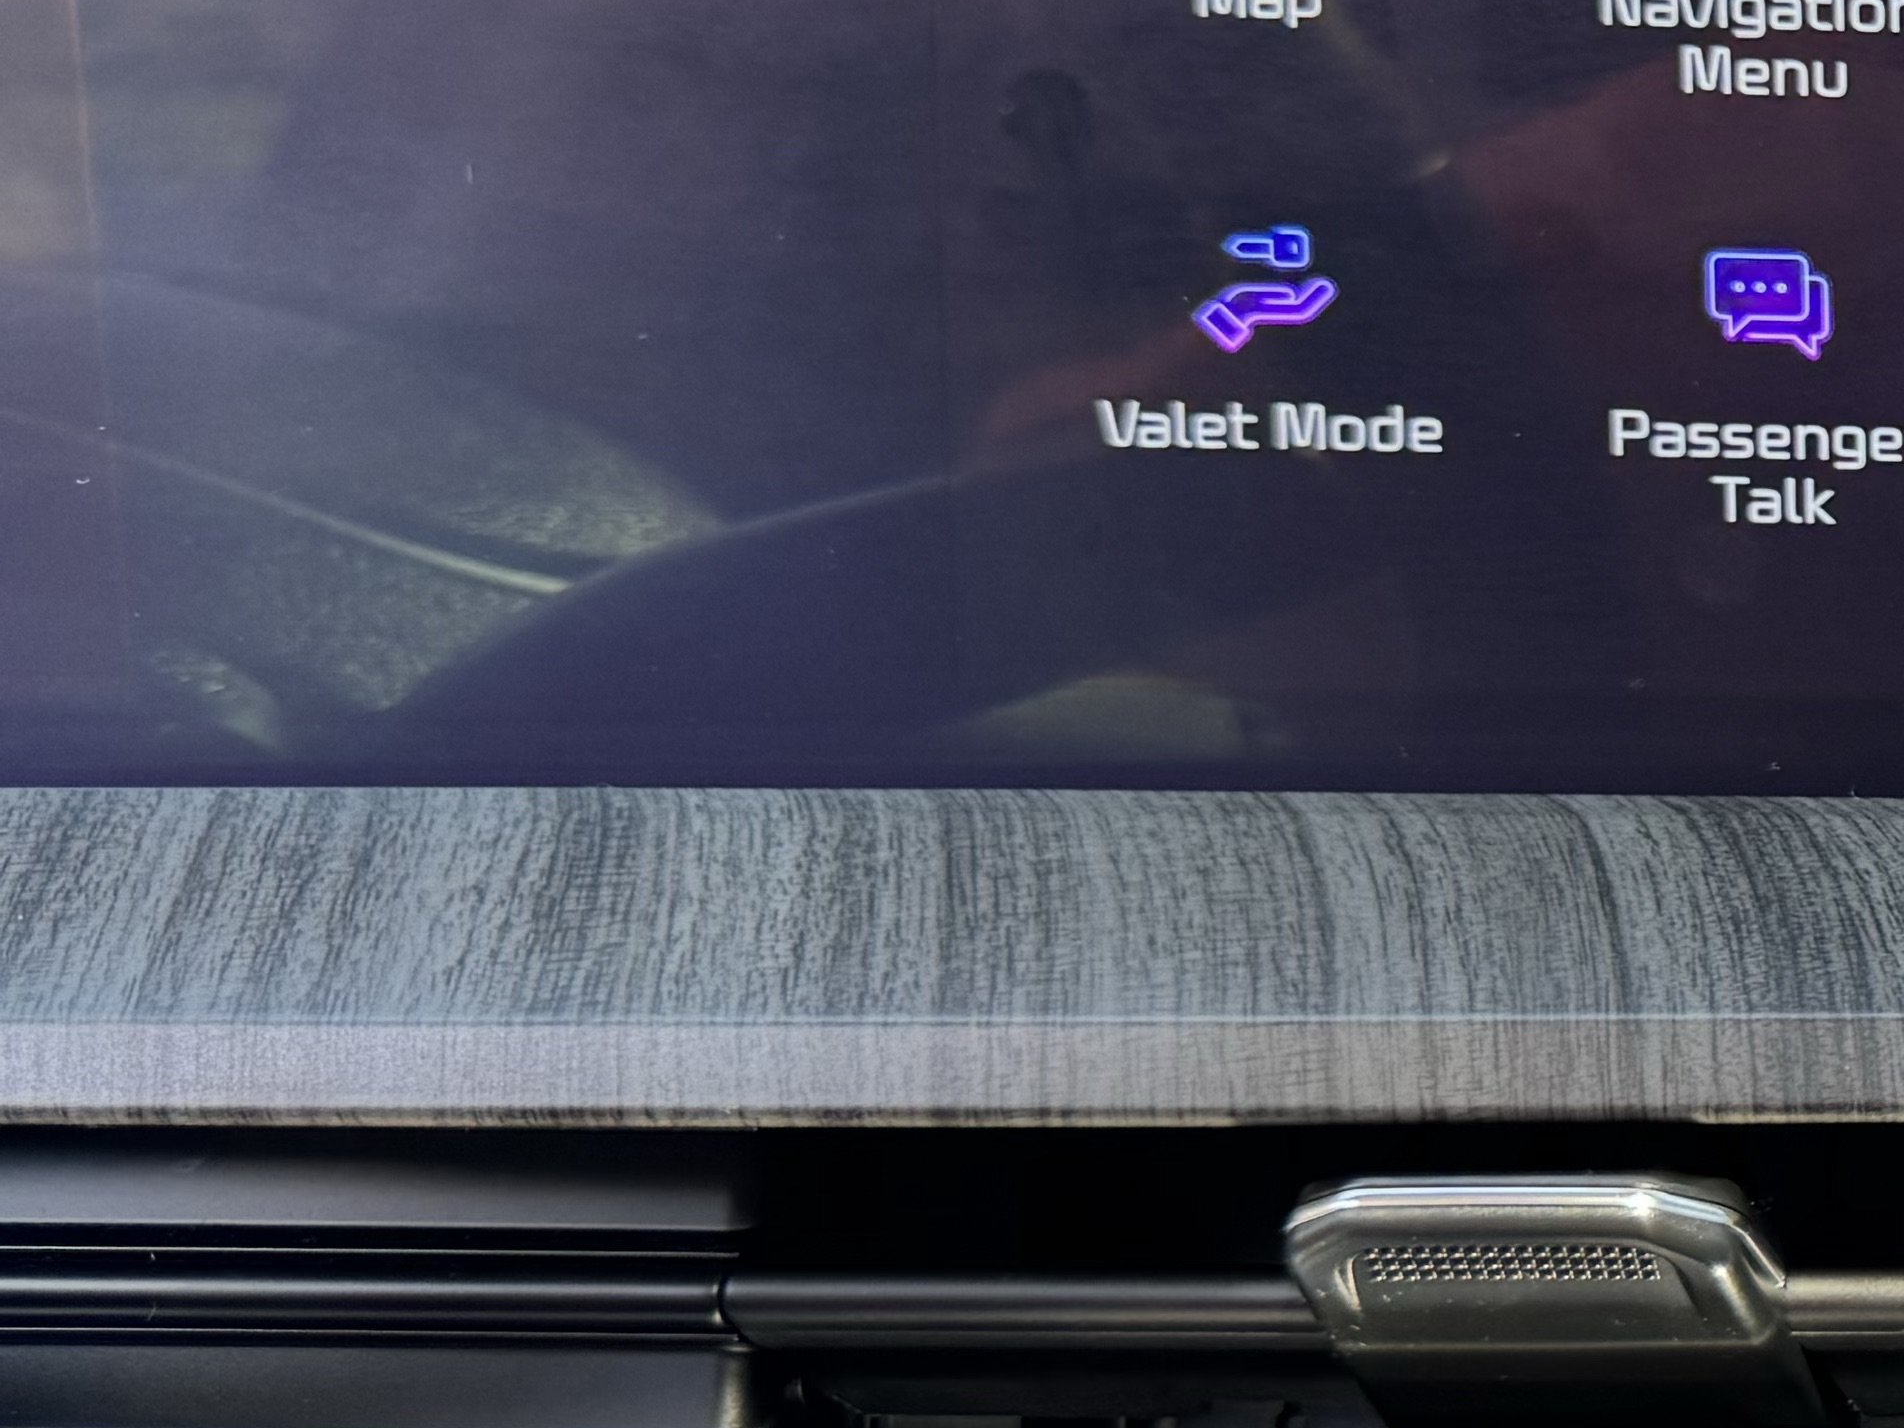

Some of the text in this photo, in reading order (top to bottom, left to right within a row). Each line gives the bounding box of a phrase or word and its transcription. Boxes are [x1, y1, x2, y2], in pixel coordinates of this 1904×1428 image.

[1680, 45, 1847, 97] Menu
[1097, 400, 1442, 452] Valet Mode
[1710, 476, 1836, 524] Talk
